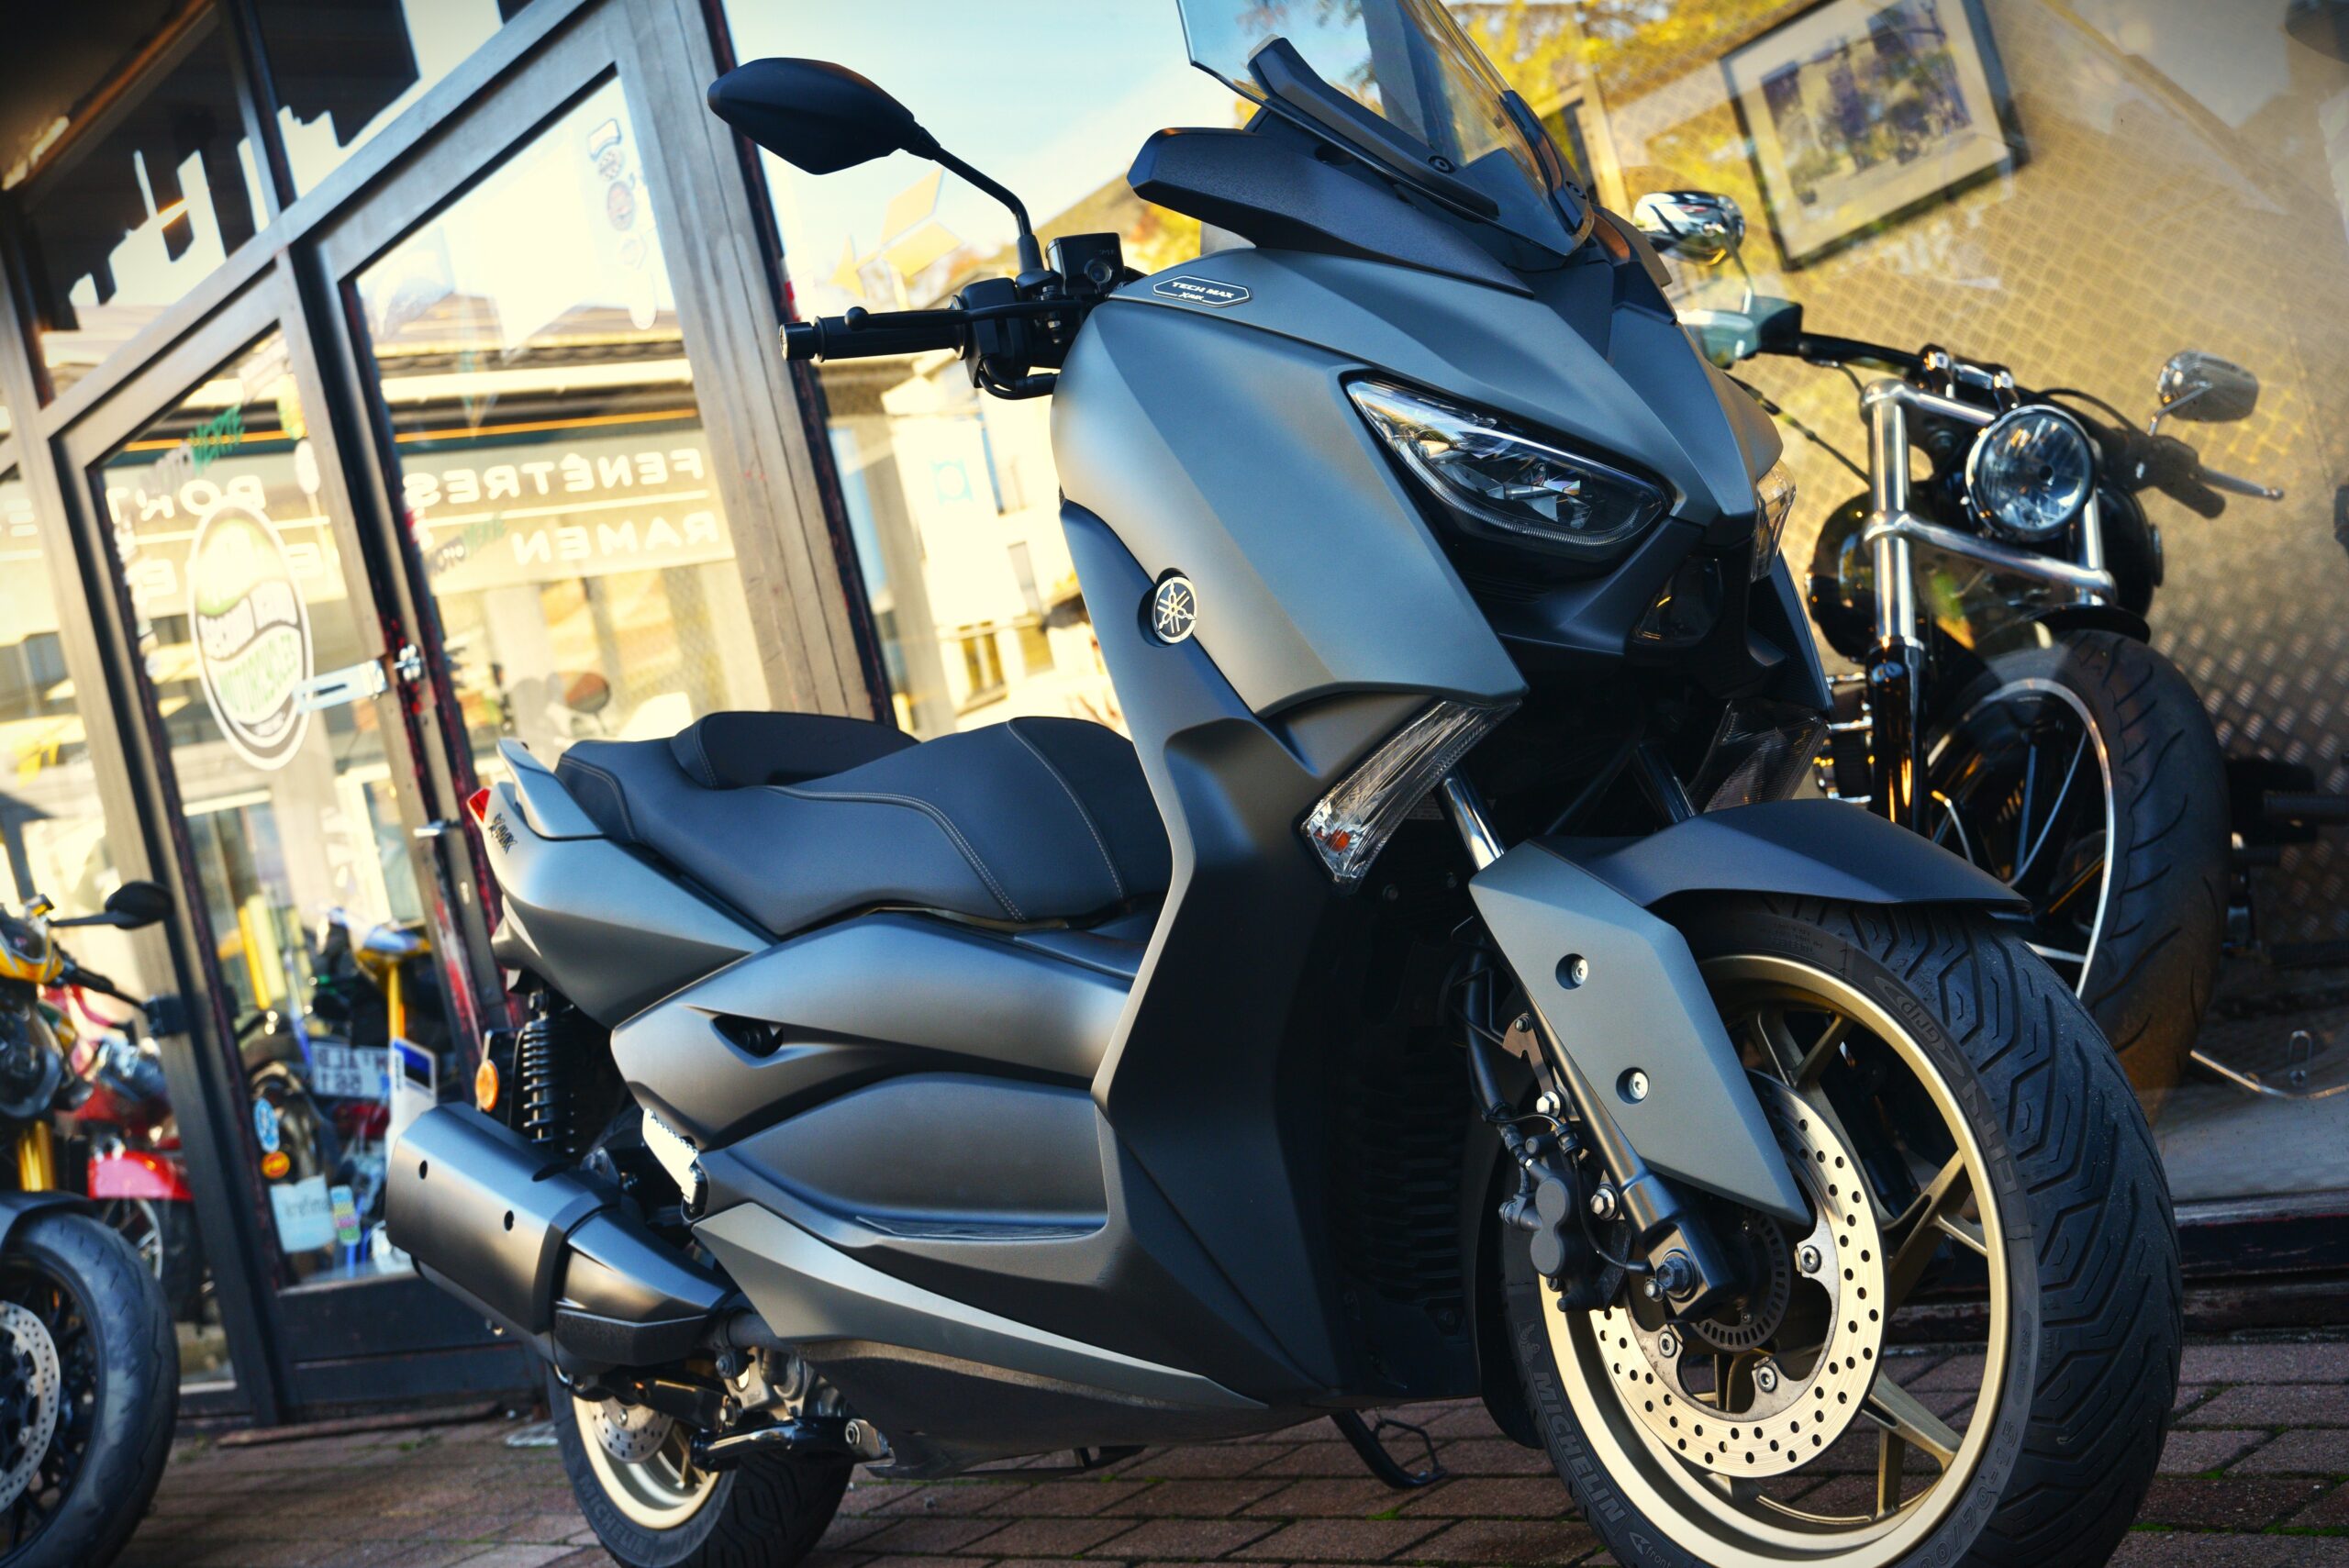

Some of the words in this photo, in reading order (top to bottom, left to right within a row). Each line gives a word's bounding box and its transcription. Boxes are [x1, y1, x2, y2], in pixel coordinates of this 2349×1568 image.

[1172, 282, 1206, 293] TECH
[1206, 288, 1234, 299] MAX
[1533, 1372, 1626, 1523] MICHELIN
[579, 1473, 646, 1555] MICHELIN
[1646, 1545, 1674, 1568] front
